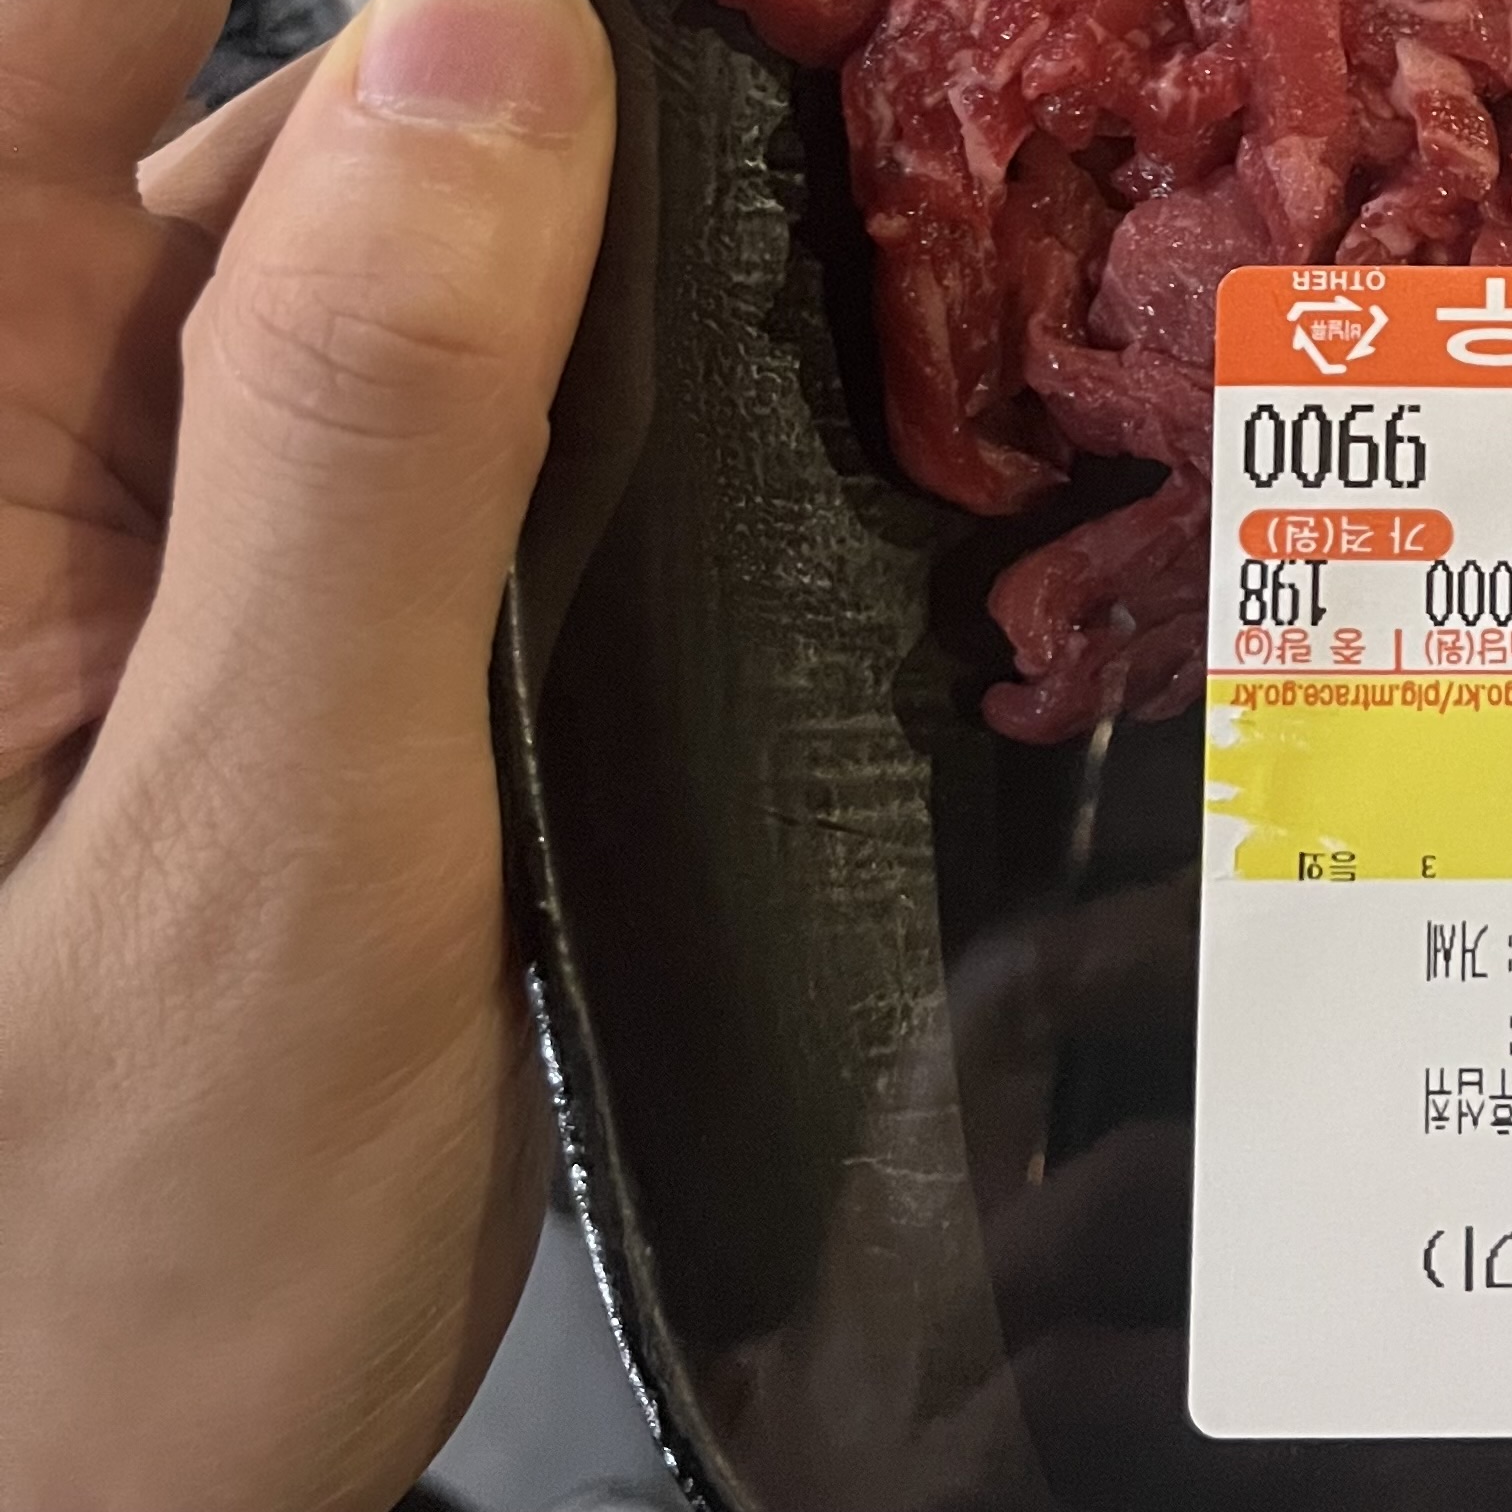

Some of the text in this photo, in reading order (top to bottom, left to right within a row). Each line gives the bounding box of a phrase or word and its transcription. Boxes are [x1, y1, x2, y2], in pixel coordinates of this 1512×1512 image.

[1292, 270, 1386, 292] OTHER
[1310, 319, 1362, 341] 비닐류
[1243, 404, 1426, 489] 9900
[1239, 559, 1328, 626] 198
[1299, 851, 1356, 881] 등외
[1421, 856, 1437, 878] 3
[1426, 921, 1488, 982] 거세
